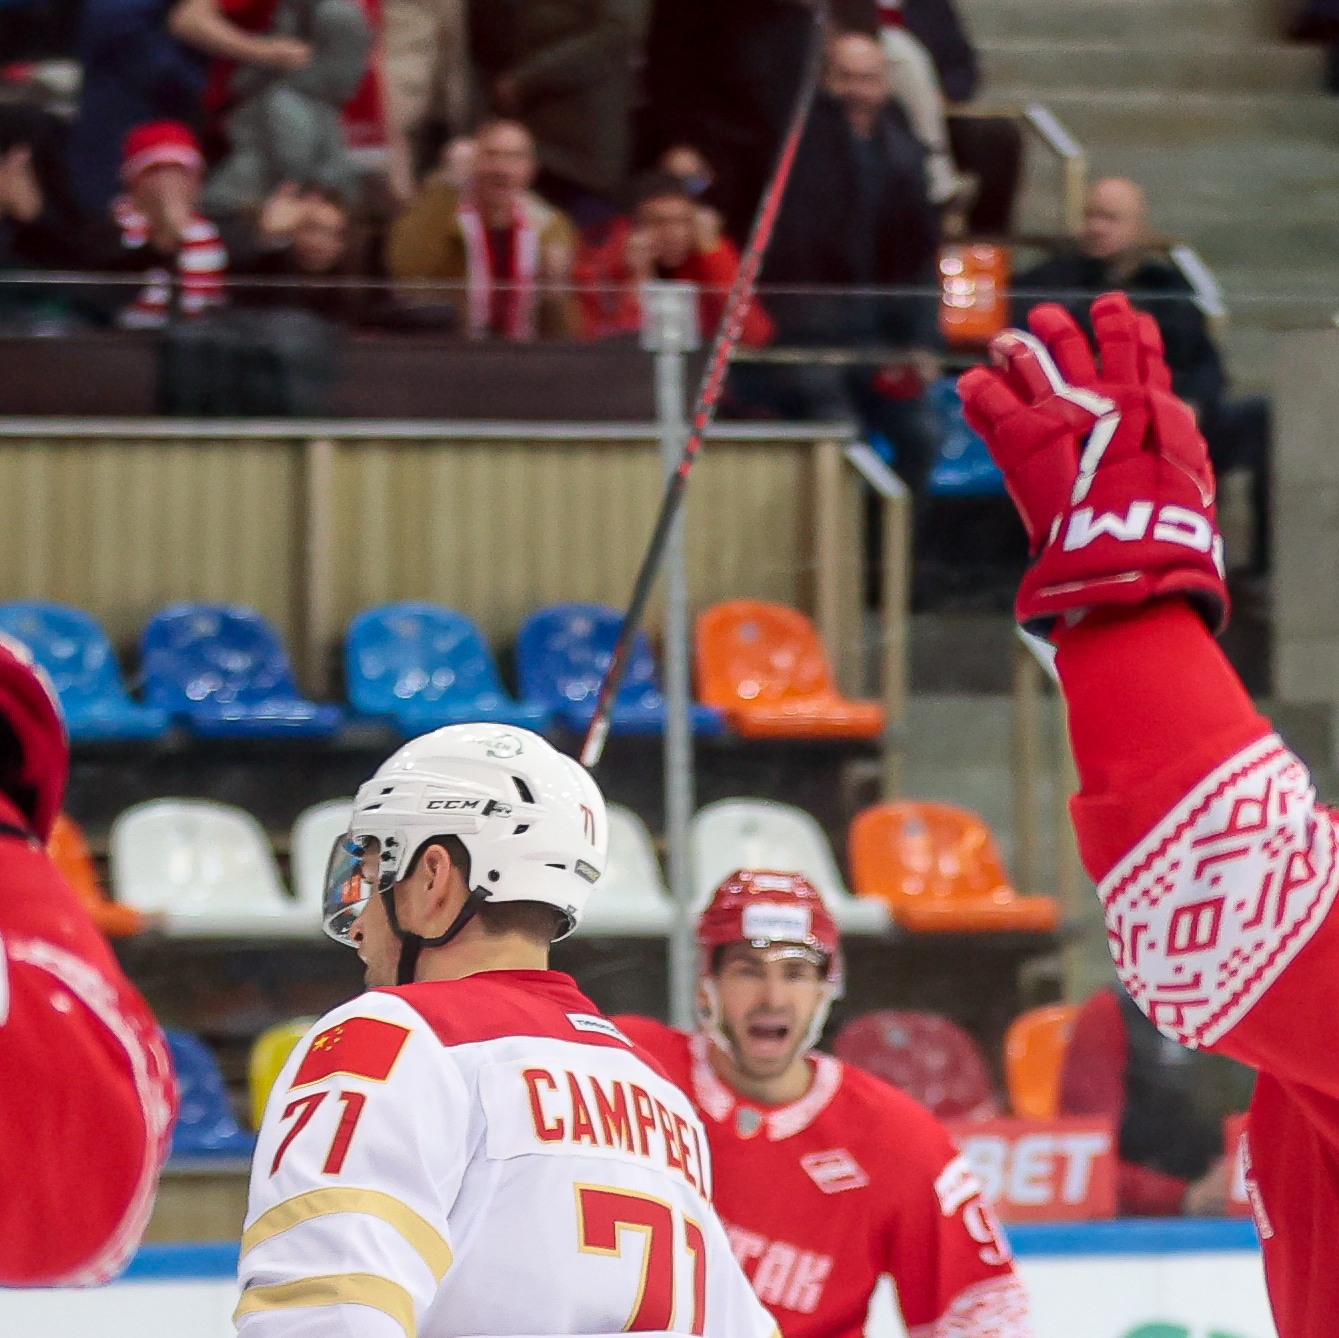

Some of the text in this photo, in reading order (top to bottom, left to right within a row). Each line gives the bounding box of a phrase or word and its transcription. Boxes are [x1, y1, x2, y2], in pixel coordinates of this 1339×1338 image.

[426, 799, 481, 811] CCM
[270, 1091, 368, 1176] 71
[574, 1182, 707, 1332] 71
